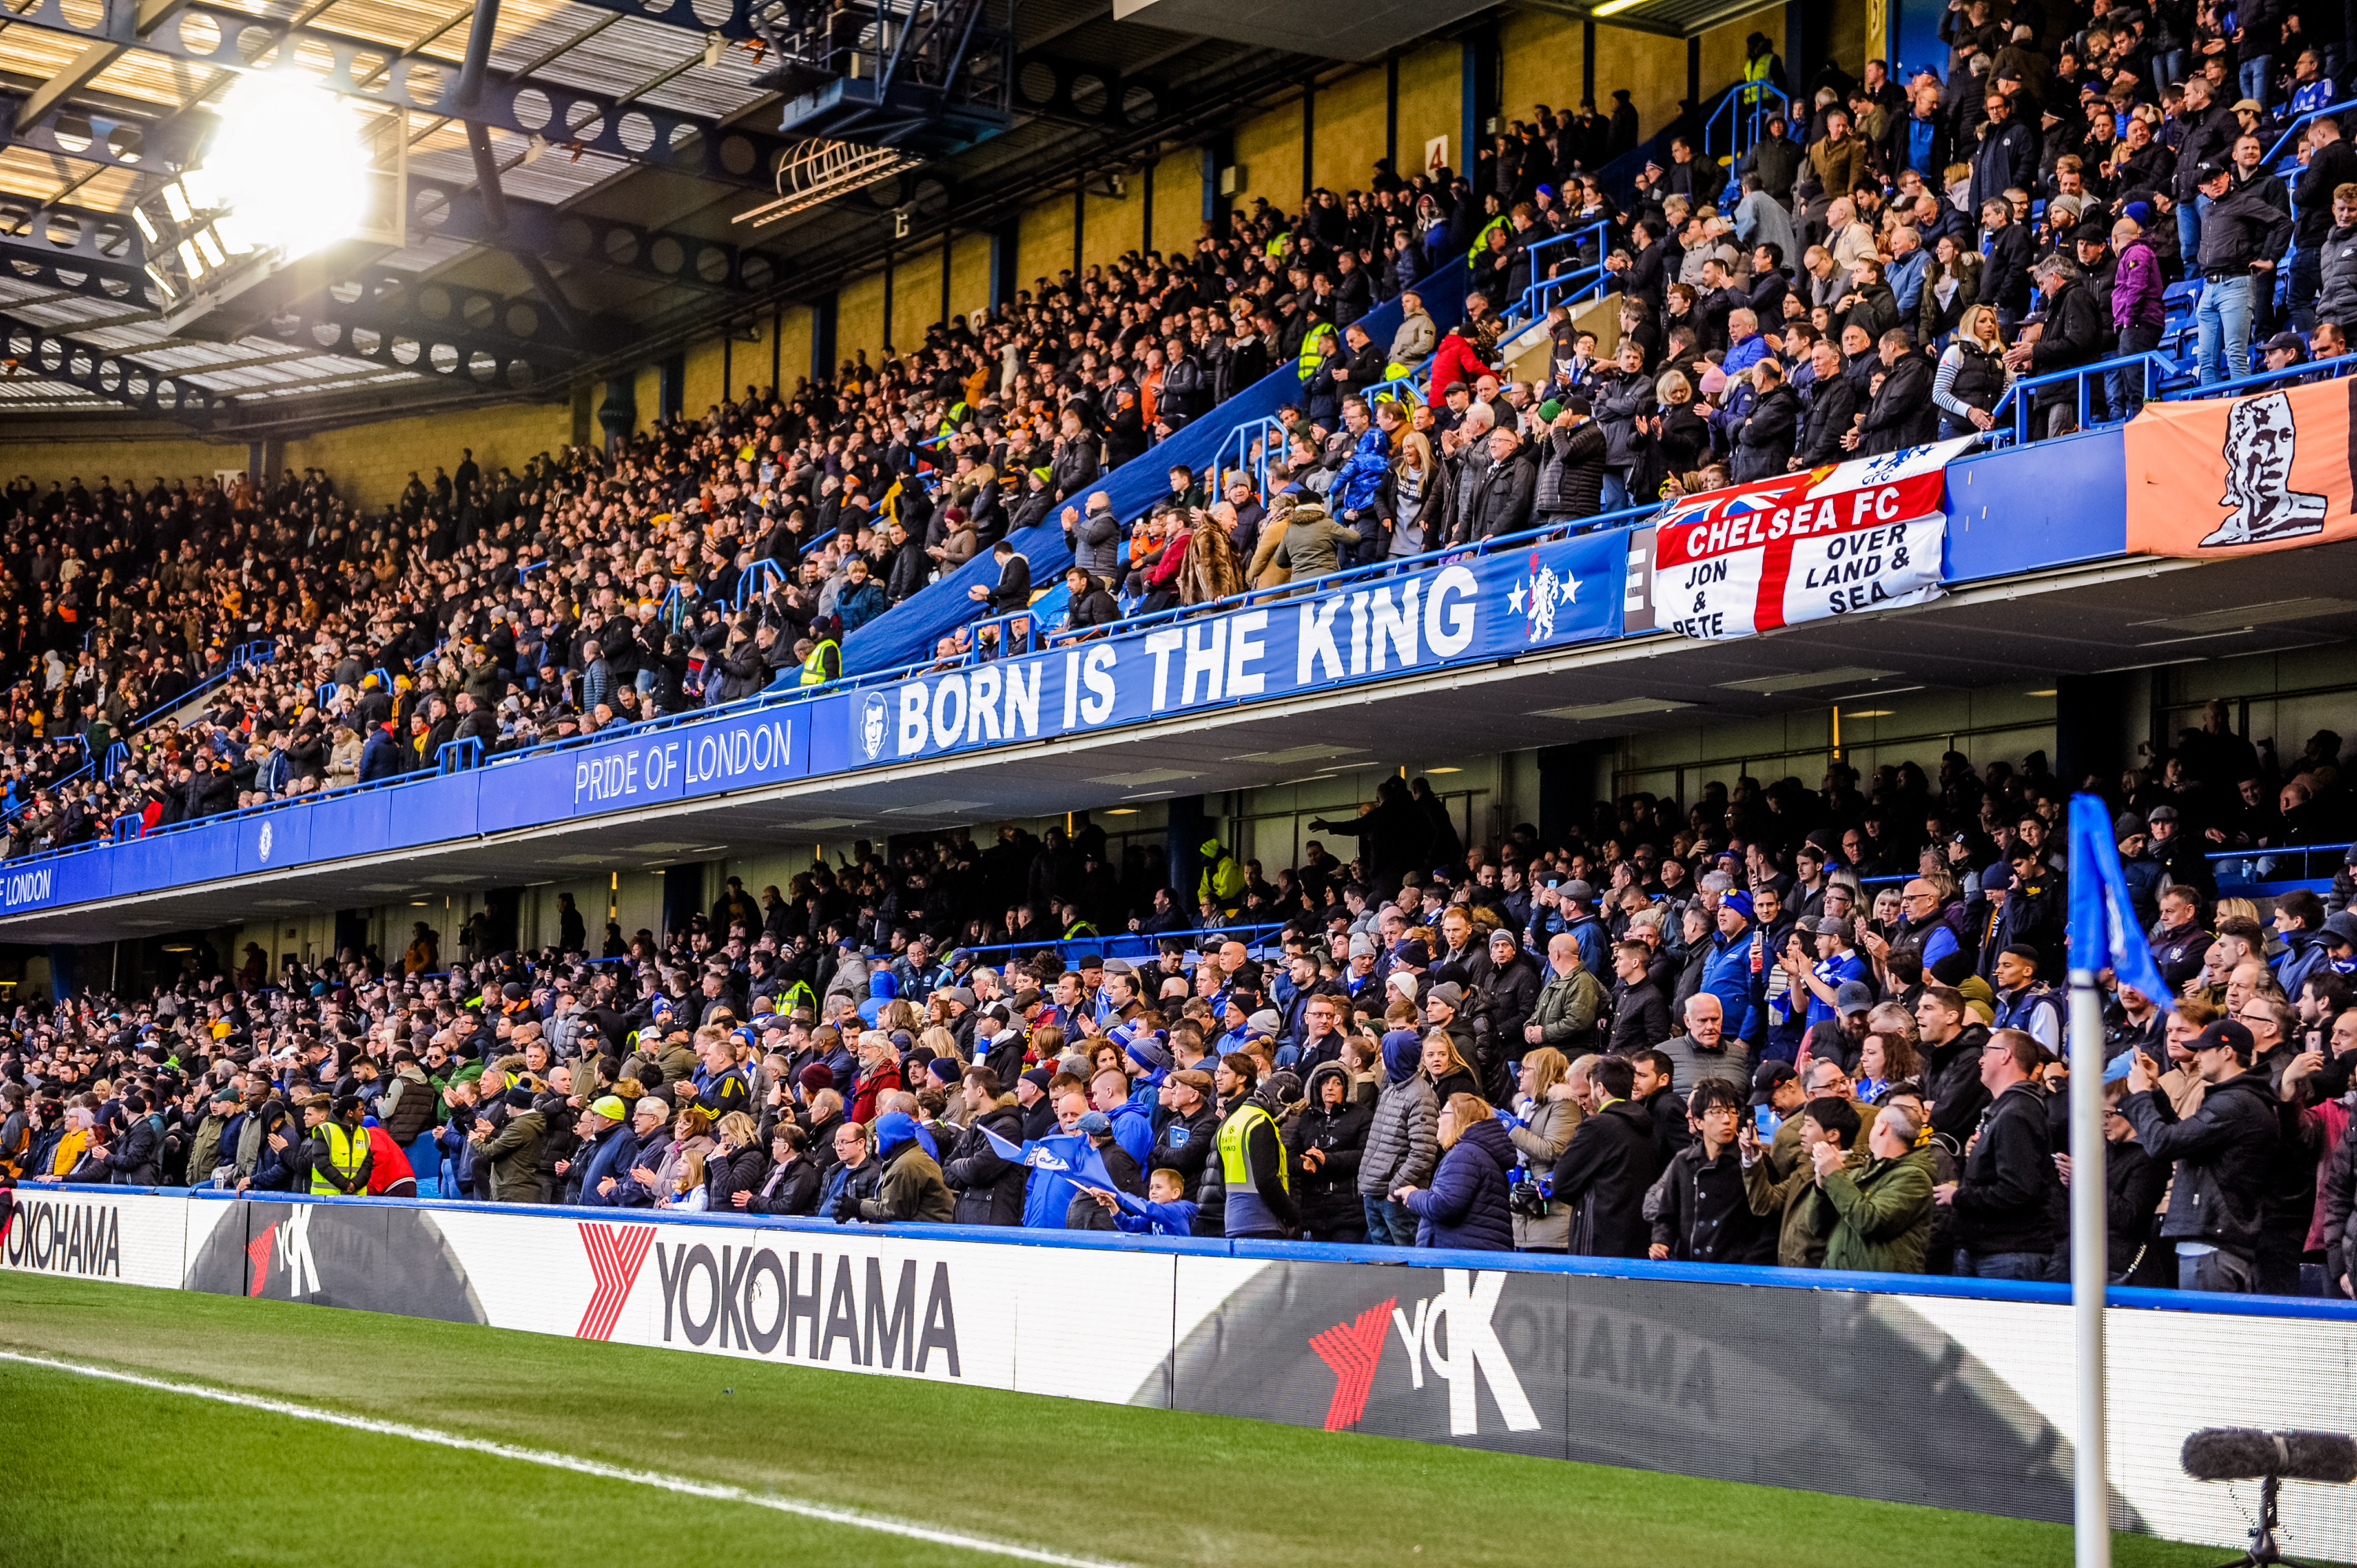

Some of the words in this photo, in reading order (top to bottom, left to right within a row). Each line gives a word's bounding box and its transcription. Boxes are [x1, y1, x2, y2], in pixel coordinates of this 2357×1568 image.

[1429, 143, 1443, 170] 4
[1687, 498, 1837, 558] CHELSEA
[1851, 486, 1900, 525] FC
[1827, 522, 1907, 560] OVER
[1684, 559, 1727, 590] JON
[1805, 555, 1881, 589] LAND
[1890, 547, 1910, 570] &
[1692, 590, 1706, 614] &
[1828, 581, 1890, 614] SEA
[1672, 611, 1724, 639] PETE
[897, 661, 1043, 757] BORN
[1062, 643, 1118, 730] IS
[1144, 609, 1269, 712] THE
[1296, 566, 1478, 686] KING
[574, 749, 639, 804] PRIDE
[644, 742, 679, 791] OF
[684, 718, 792, 784] LONDON
[5, 867, 52, 907] LONDON
[0, 1200, 119, 1277] OKOHAMA
[655, 1241, 962, 1378] YOKOHAMA
